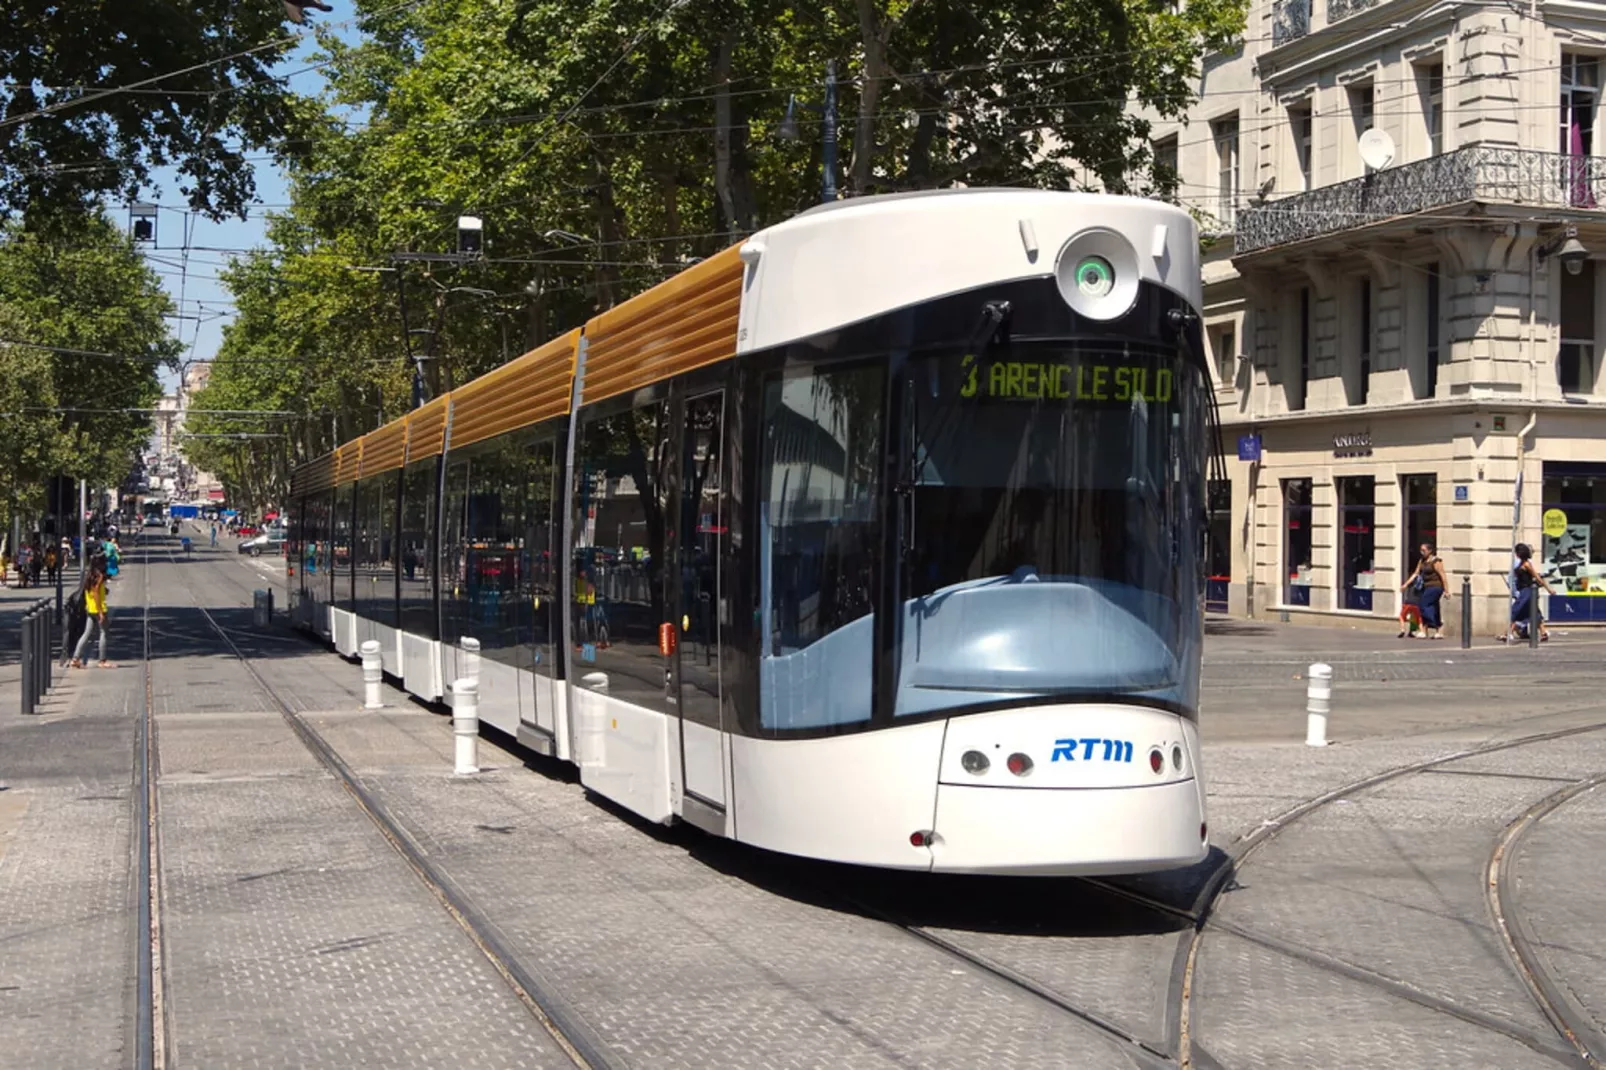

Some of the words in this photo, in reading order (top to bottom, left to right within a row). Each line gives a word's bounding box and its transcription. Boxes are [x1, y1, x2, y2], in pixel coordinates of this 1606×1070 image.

[960, 354, 978, 397] 3
[988, 361, 1072, 399] ARENC
[1076, 365, 1109, 400] LE
[1114, 367, 1173, 402] SILO
[1051, 738, 1134, 763] RTM
